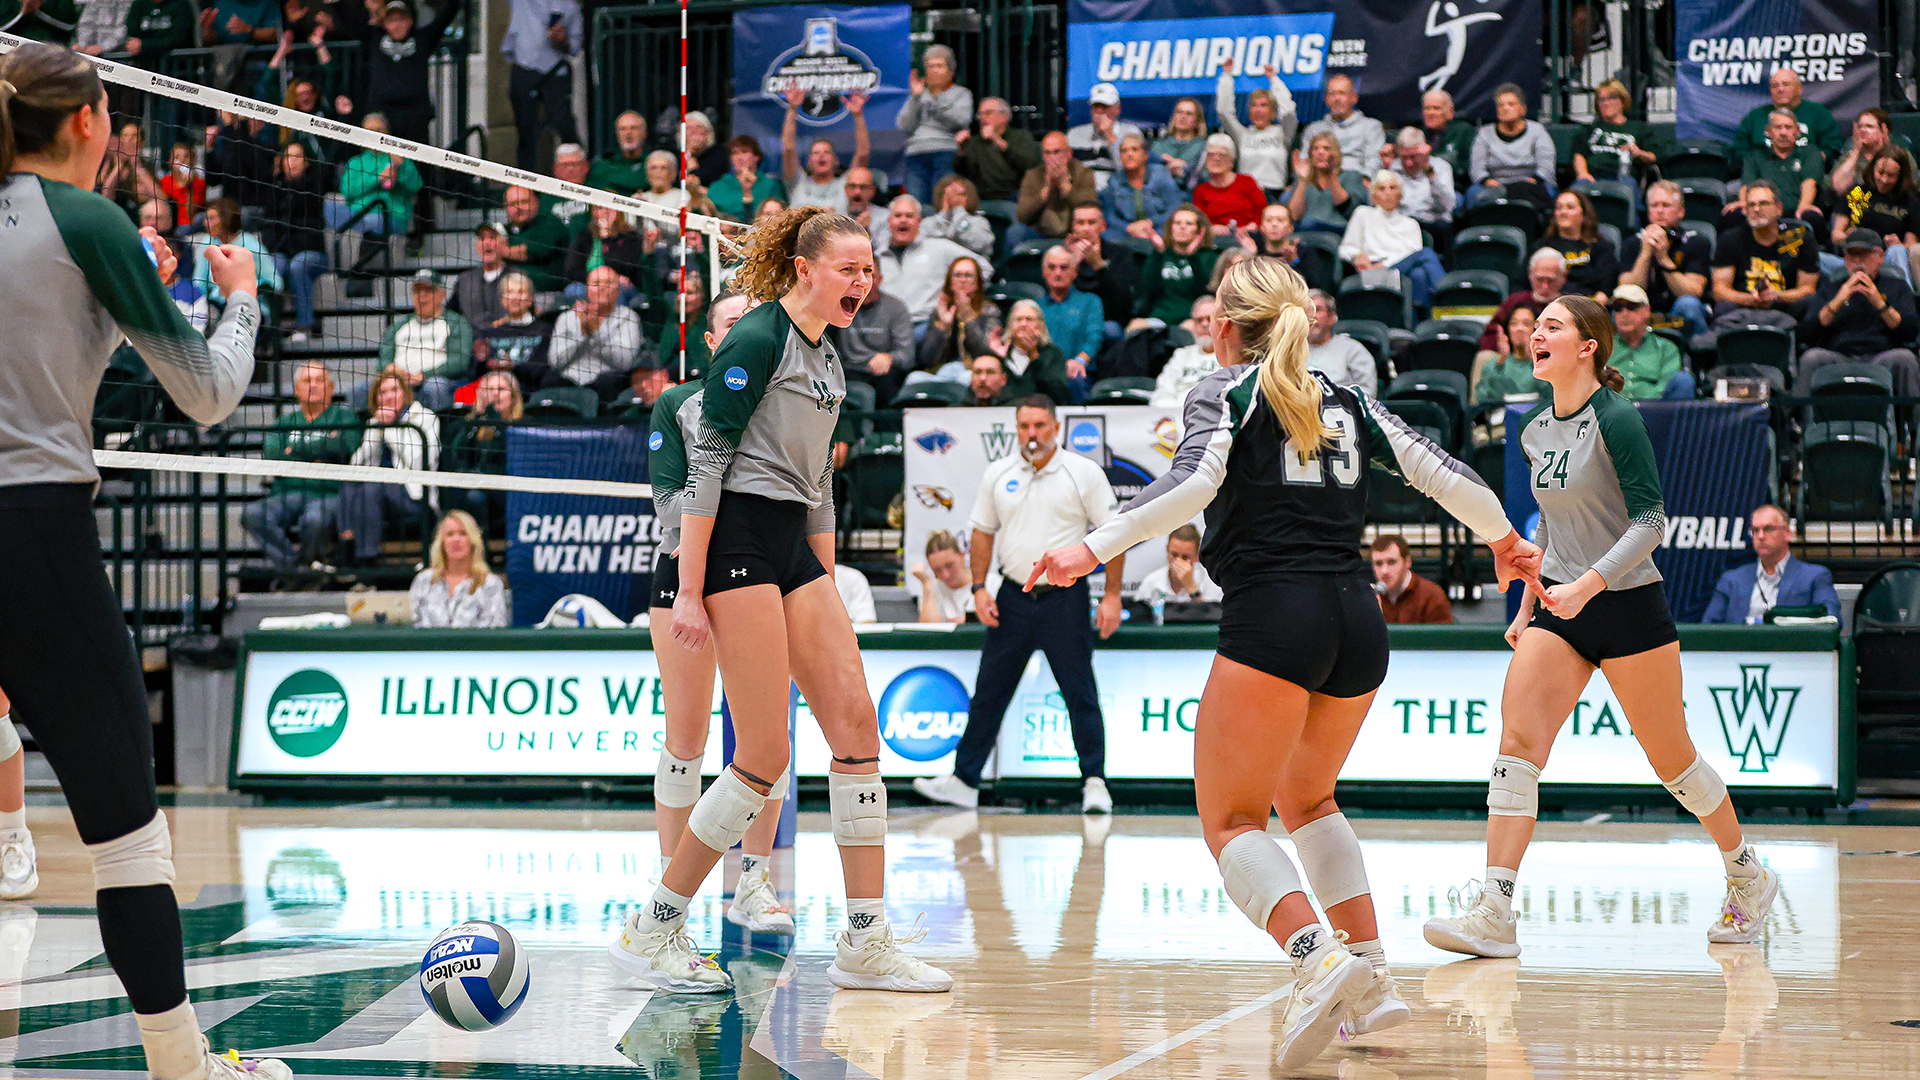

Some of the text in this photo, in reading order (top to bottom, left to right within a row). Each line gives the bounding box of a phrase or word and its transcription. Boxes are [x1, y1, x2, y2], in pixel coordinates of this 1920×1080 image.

[1098, 33, 1325, 82] CHAMPIONS
[1687, 31, 1868, 63] CHAMPIONS
[1701, 61, 1764, 87] WIN
[726, 376, 747, 386] NCAA
[1535, 449, 1572, 490] 24
[1661, 515, 1747, 550] YBALL
[533, 545, 659, 573] WIN HE
[380, 676, 580, 716] ILLINOIS
[269, 699, 346, 728] CCIW
[883, 711, 969, 740] NCAA
[1024, 712, 1069, 733] SHI
[1141, 697, 1201, 733] HO
[1392, 698, 1488, 735] THE
[487, 731, 665, 751] UNIVERS
[428, 936, 476, 964] NCAA
[426, 957, 482, 983] molten
